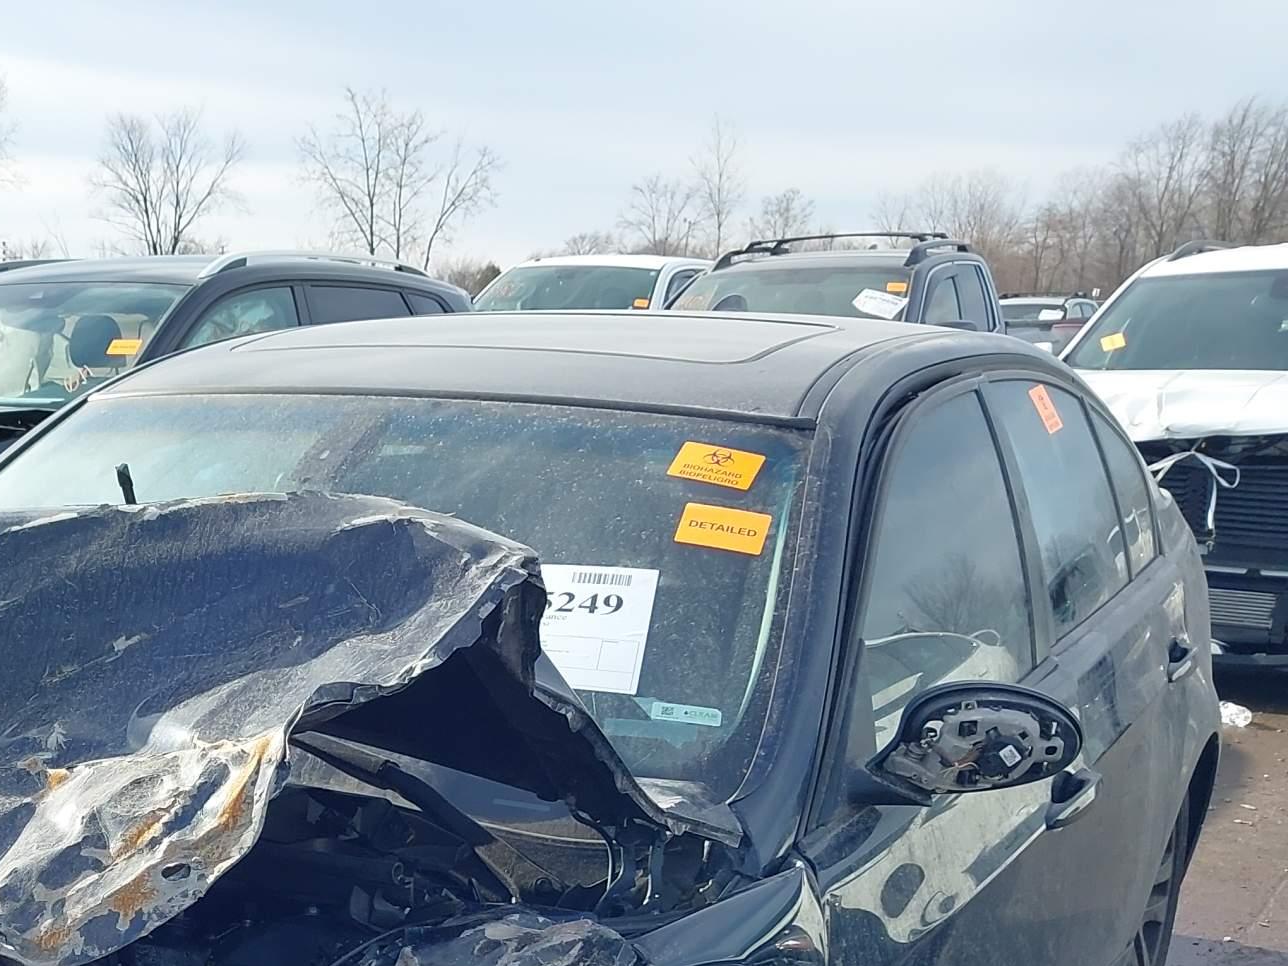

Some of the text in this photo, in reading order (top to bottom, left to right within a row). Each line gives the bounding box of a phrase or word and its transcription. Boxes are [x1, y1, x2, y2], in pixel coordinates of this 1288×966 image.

[678, 470, 739, 486] BIOPELIGRO
[682, 463, 743, 479] BIOHAZARD
[688, 519, 758, 537] DETAILED
